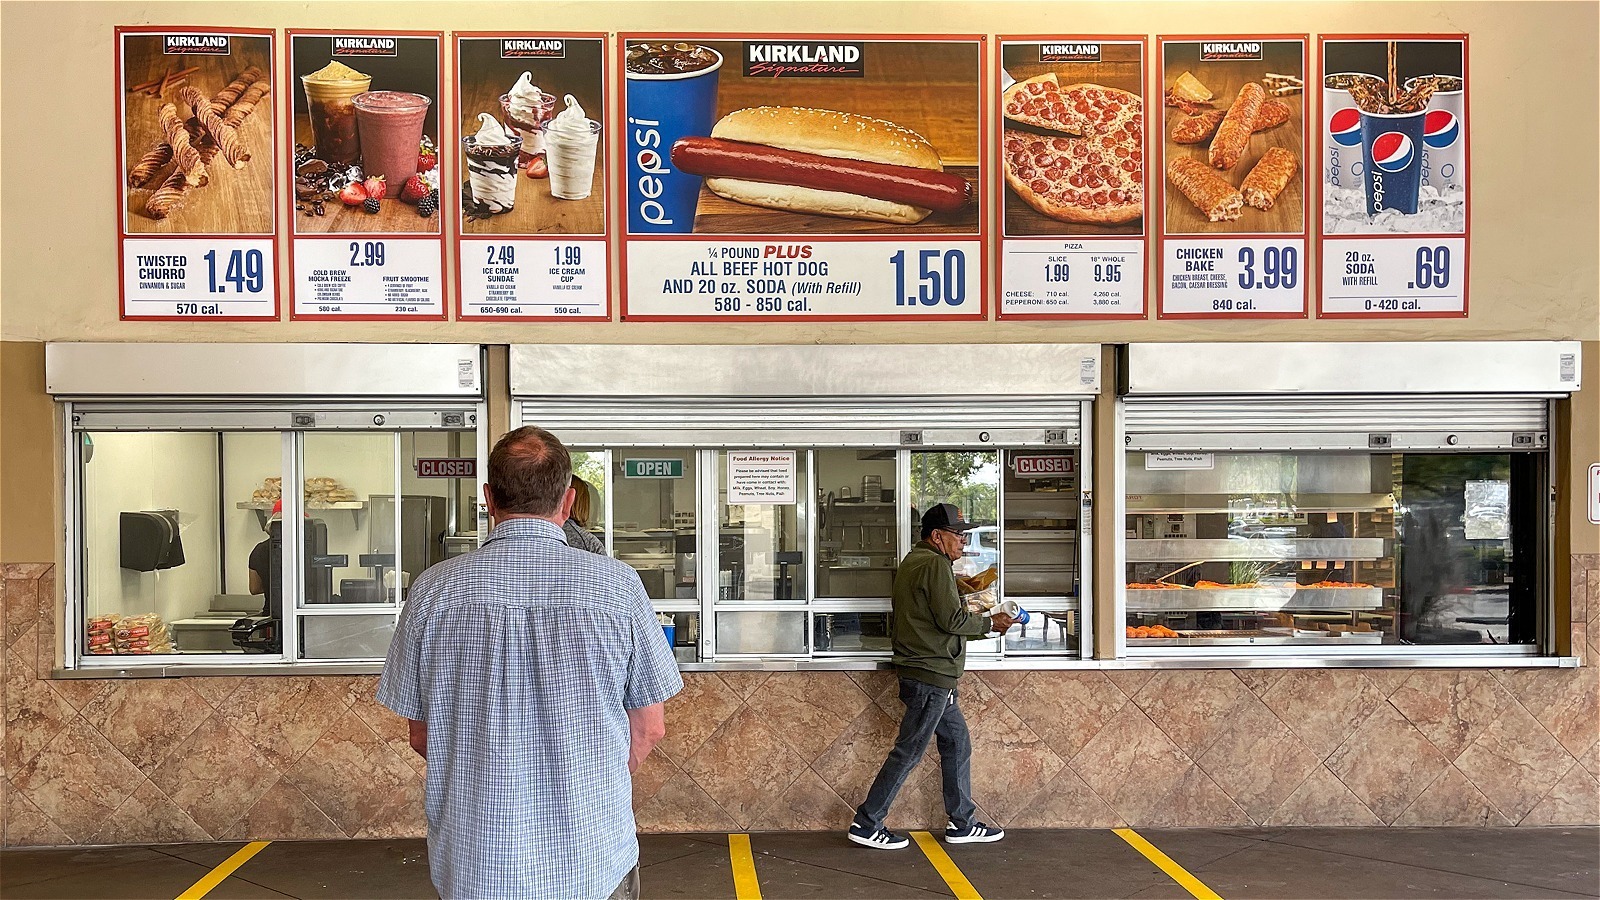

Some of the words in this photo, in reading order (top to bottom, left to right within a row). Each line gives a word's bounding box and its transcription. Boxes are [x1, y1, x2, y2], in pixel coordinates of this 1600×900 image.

[168, 36, 227, 46] KIRKLAND
[335, 38, 394, 48] KIRKLAND
[504, 40, 562, 50] KIRKLAND
[1204, 43, 1260, 52] KIRKLAND
[750, 45, 860, 62] KIRKLAND
[1043, 45, 1099, 54] KIRKLAND
[750, 61, 859, 78] Signature
[629, 117, 673, 225] pepsi
[1329, 146, 1342, 187] pepsi
[1371, 171, 1385, 212] pepsi
[350, 242, 385, 266] 2.99
[487, 246, 514, 265] 2.49
[554, 246, 581, 265] 1.99
[721, 248, 760, 259] POUND
[764, 245, 812, 258] PLUS
[1176, 248, 1223, 259] CHICKEN
[1346, 252, 1358, 262] 20
[137, 256, 186, 267] TWISTED
[1186, 261, 1214, 272] BAKE
[1238, 246, 1297, 289] 3.99
[1408, 246, 1450, 289] .69
[139, 268, 185, 280] CHURRO
[204, 249, 264, 293] 1.49
[691, 262, 718, 276] ALL
[723, 262, 758, 276] BEEF
[764, 262, 792, 276] HOT
[798, 262, 828, 276] DOG
[1045, 264, 1070, 282] 1.99
[1094, 264, 1121, 282] 9.95
[1346, 264, 1374, 274] SODA
[890, 249, 966, 306] 1.50
[1343, 277, 1358, 285] WITH
[1359, 277, 1378, 285] REFILL
[663, 280, 693, 294] AND
[698, 280, 715, 294] 20
[721, 283, 740, 294] oz.
[746, 280, 786, 294] SODA
[792, 282, 822, 296] (With
[826, 282, 861, 296] Refill)
[177, 304, 197, 314] 570
[201, 304, 223, 314] cal.
[715, 298, 740, 312] 580
[756, 298, 782, 312] 850
[788, 298, 812, 312] cal.
[1213, 300, 1232, 310] 840
[1236, 299, 1256, 310] cal.
[1402, 299, 1420, 310] cal.
[422, 462, 473, 475] CLOSED
[637, 462, 671, 475] OPEN
[1020, 459, 1070, 471] CLOSED
